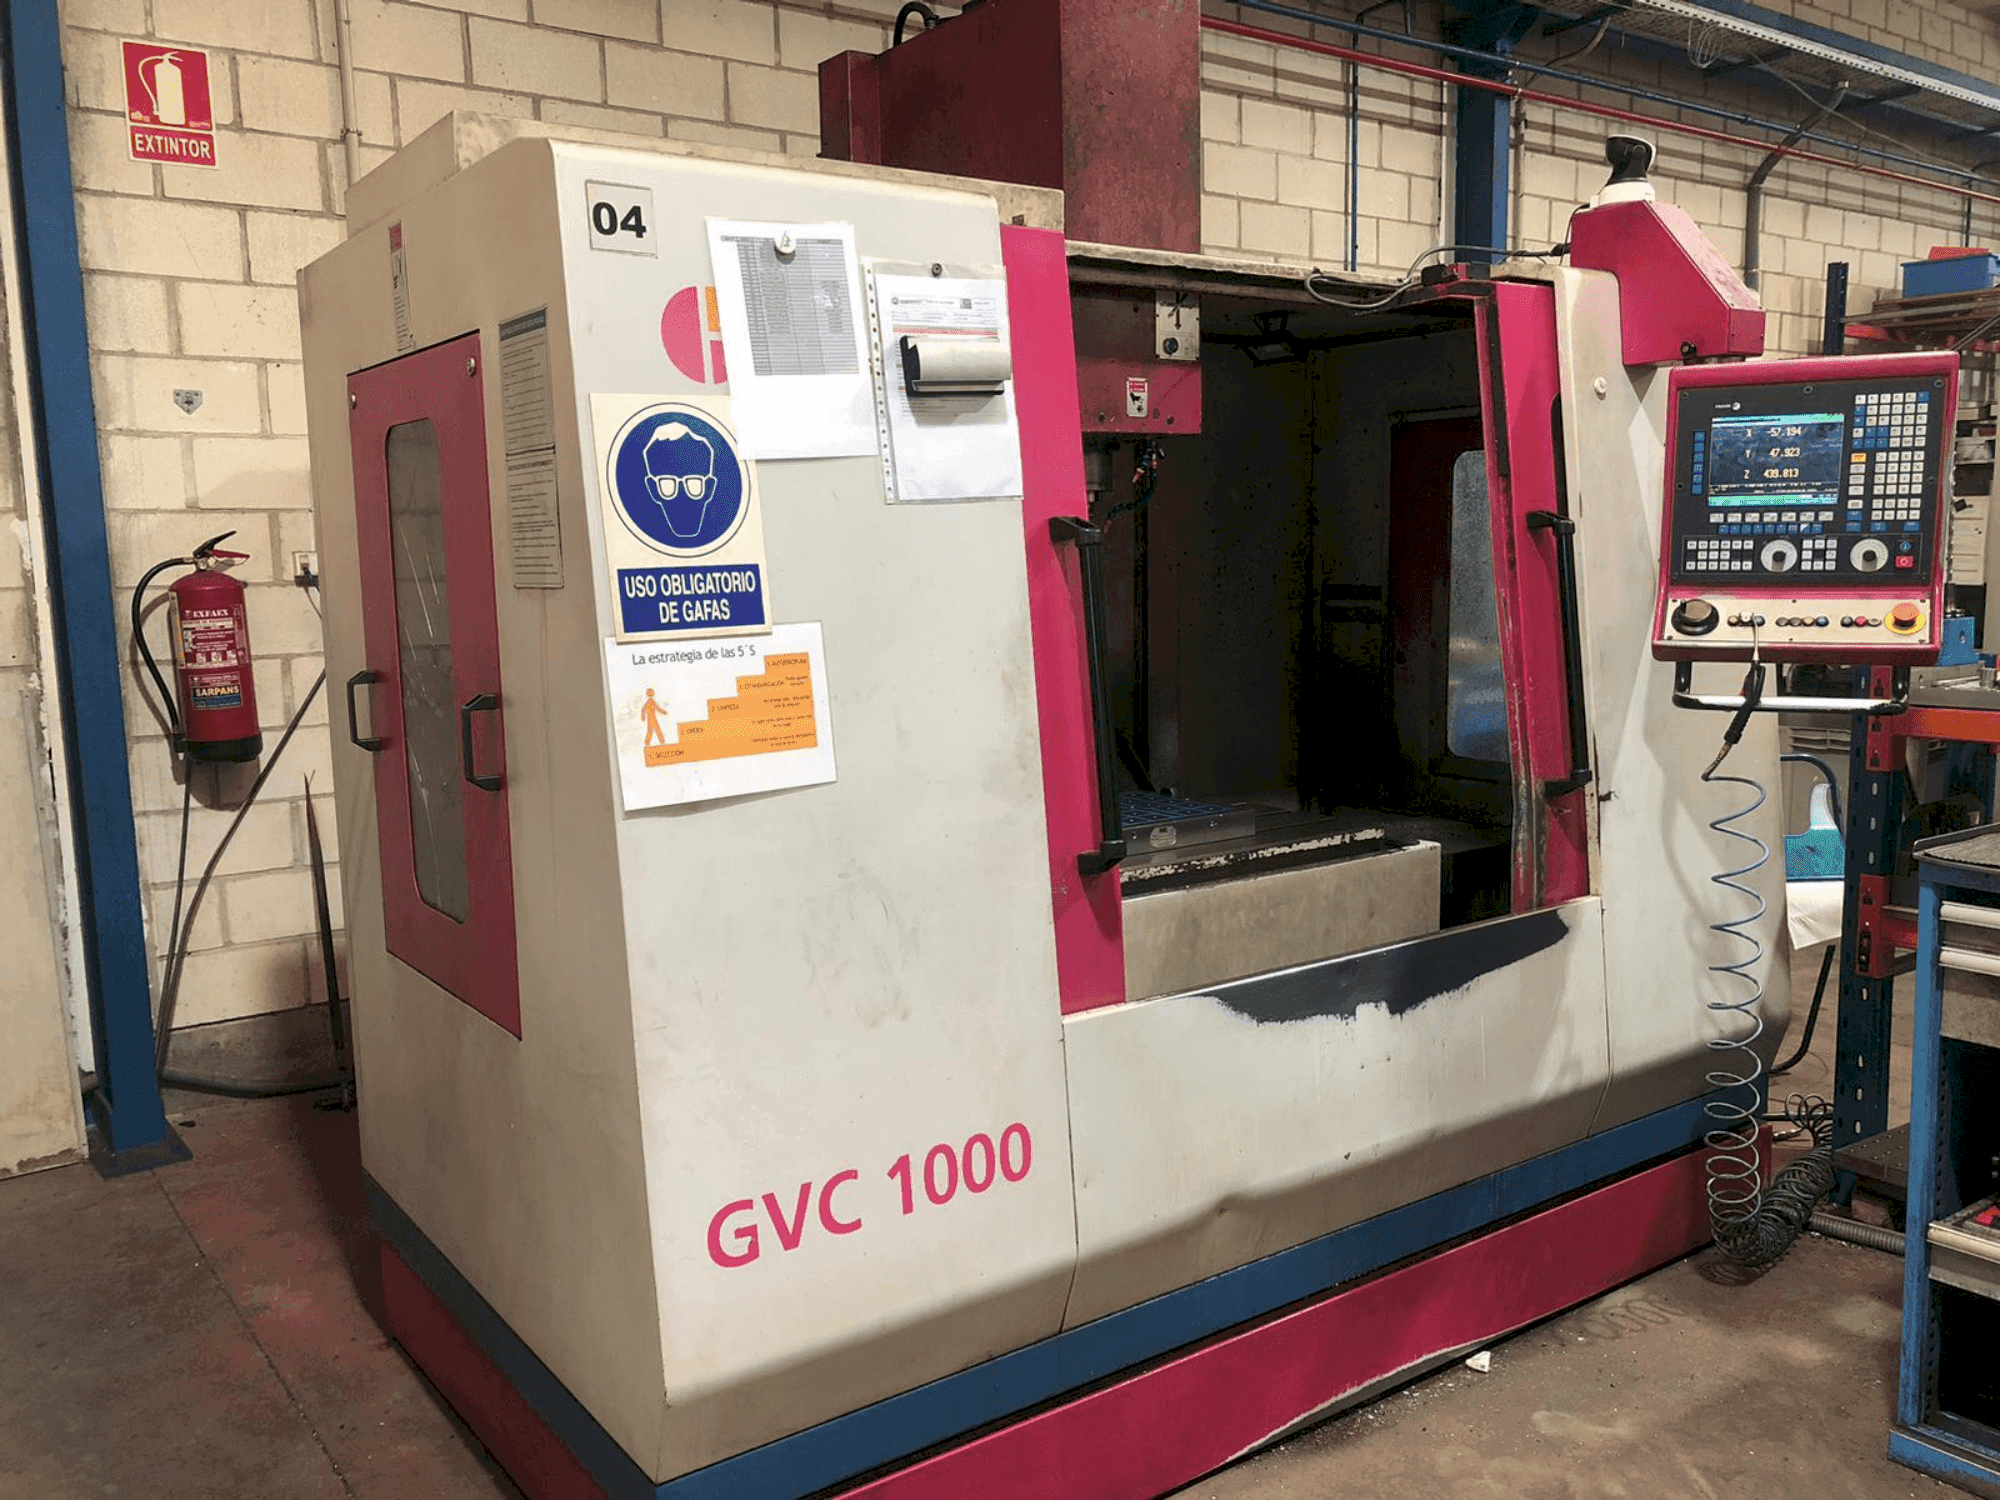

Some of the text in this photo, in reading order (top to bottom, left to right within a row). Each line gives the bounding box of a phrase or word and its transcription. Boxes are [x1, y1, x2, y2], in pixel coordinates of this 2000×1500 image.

[135, 133, 211, 159] EXTINTOR
[592, 202, 647, 239] 04
[1746, 428, 1752, 437] X
[1745, 449, 1751, 459] Y
[1744, 469, 1750, 479] Z
[624, 570, 756, 598] USO OBLIGATORIO
[659, 598, 731, 624] DE GAFAS
[632, 653, 646, 666] La
[649, 649, 703, 664] estrategia
[705, 647, 719, 660] de
[721, 646, 736, 659] las
[706, 1121, 1033, 1270] GVC 1000
